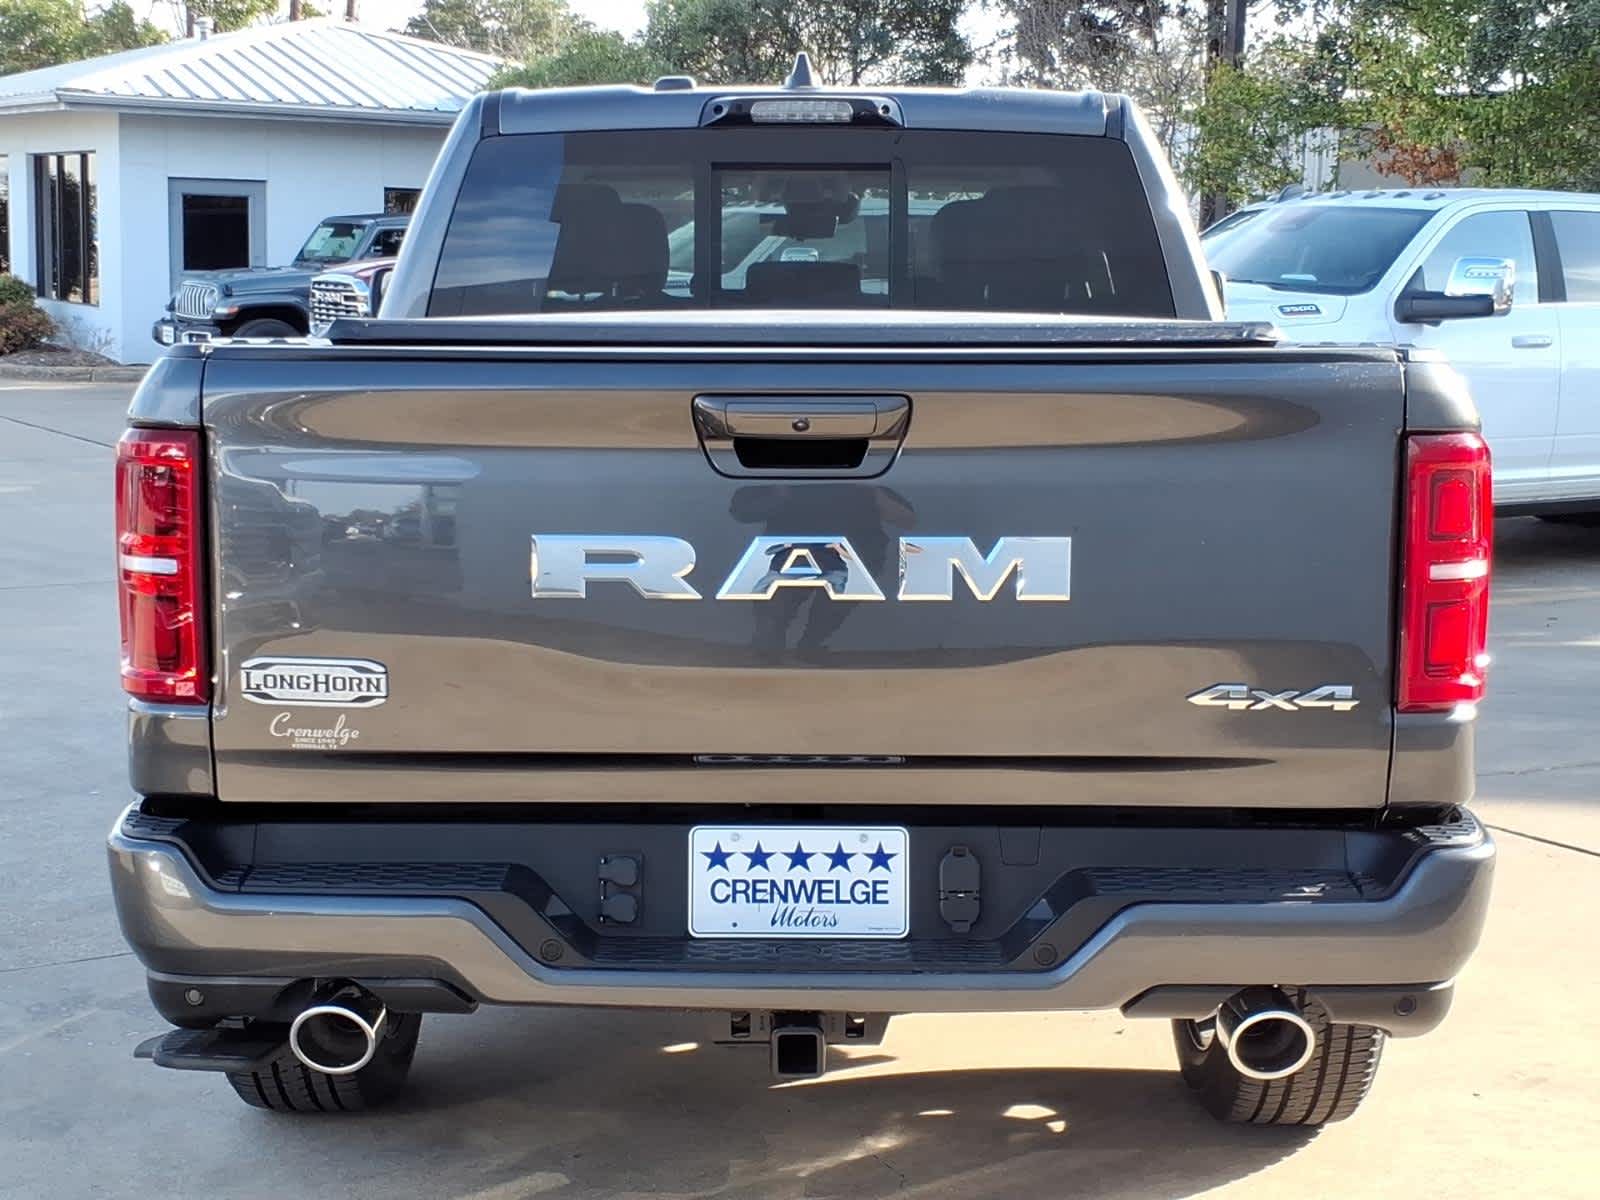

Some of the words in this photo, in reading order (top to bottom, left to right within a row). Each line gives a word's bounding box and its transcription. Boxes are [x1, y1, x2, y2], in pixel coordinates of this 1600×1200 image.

[1282, 305, 1317, 313] 3500
[531, 534, 1073, 602] RAM
[1186, 684, 1361, 711] 4x4
[269, 712, 360, 745] Crenwelge
[710, 878, 889, 905] CRENWELGE
[770, 903, 839, 928] Motors
